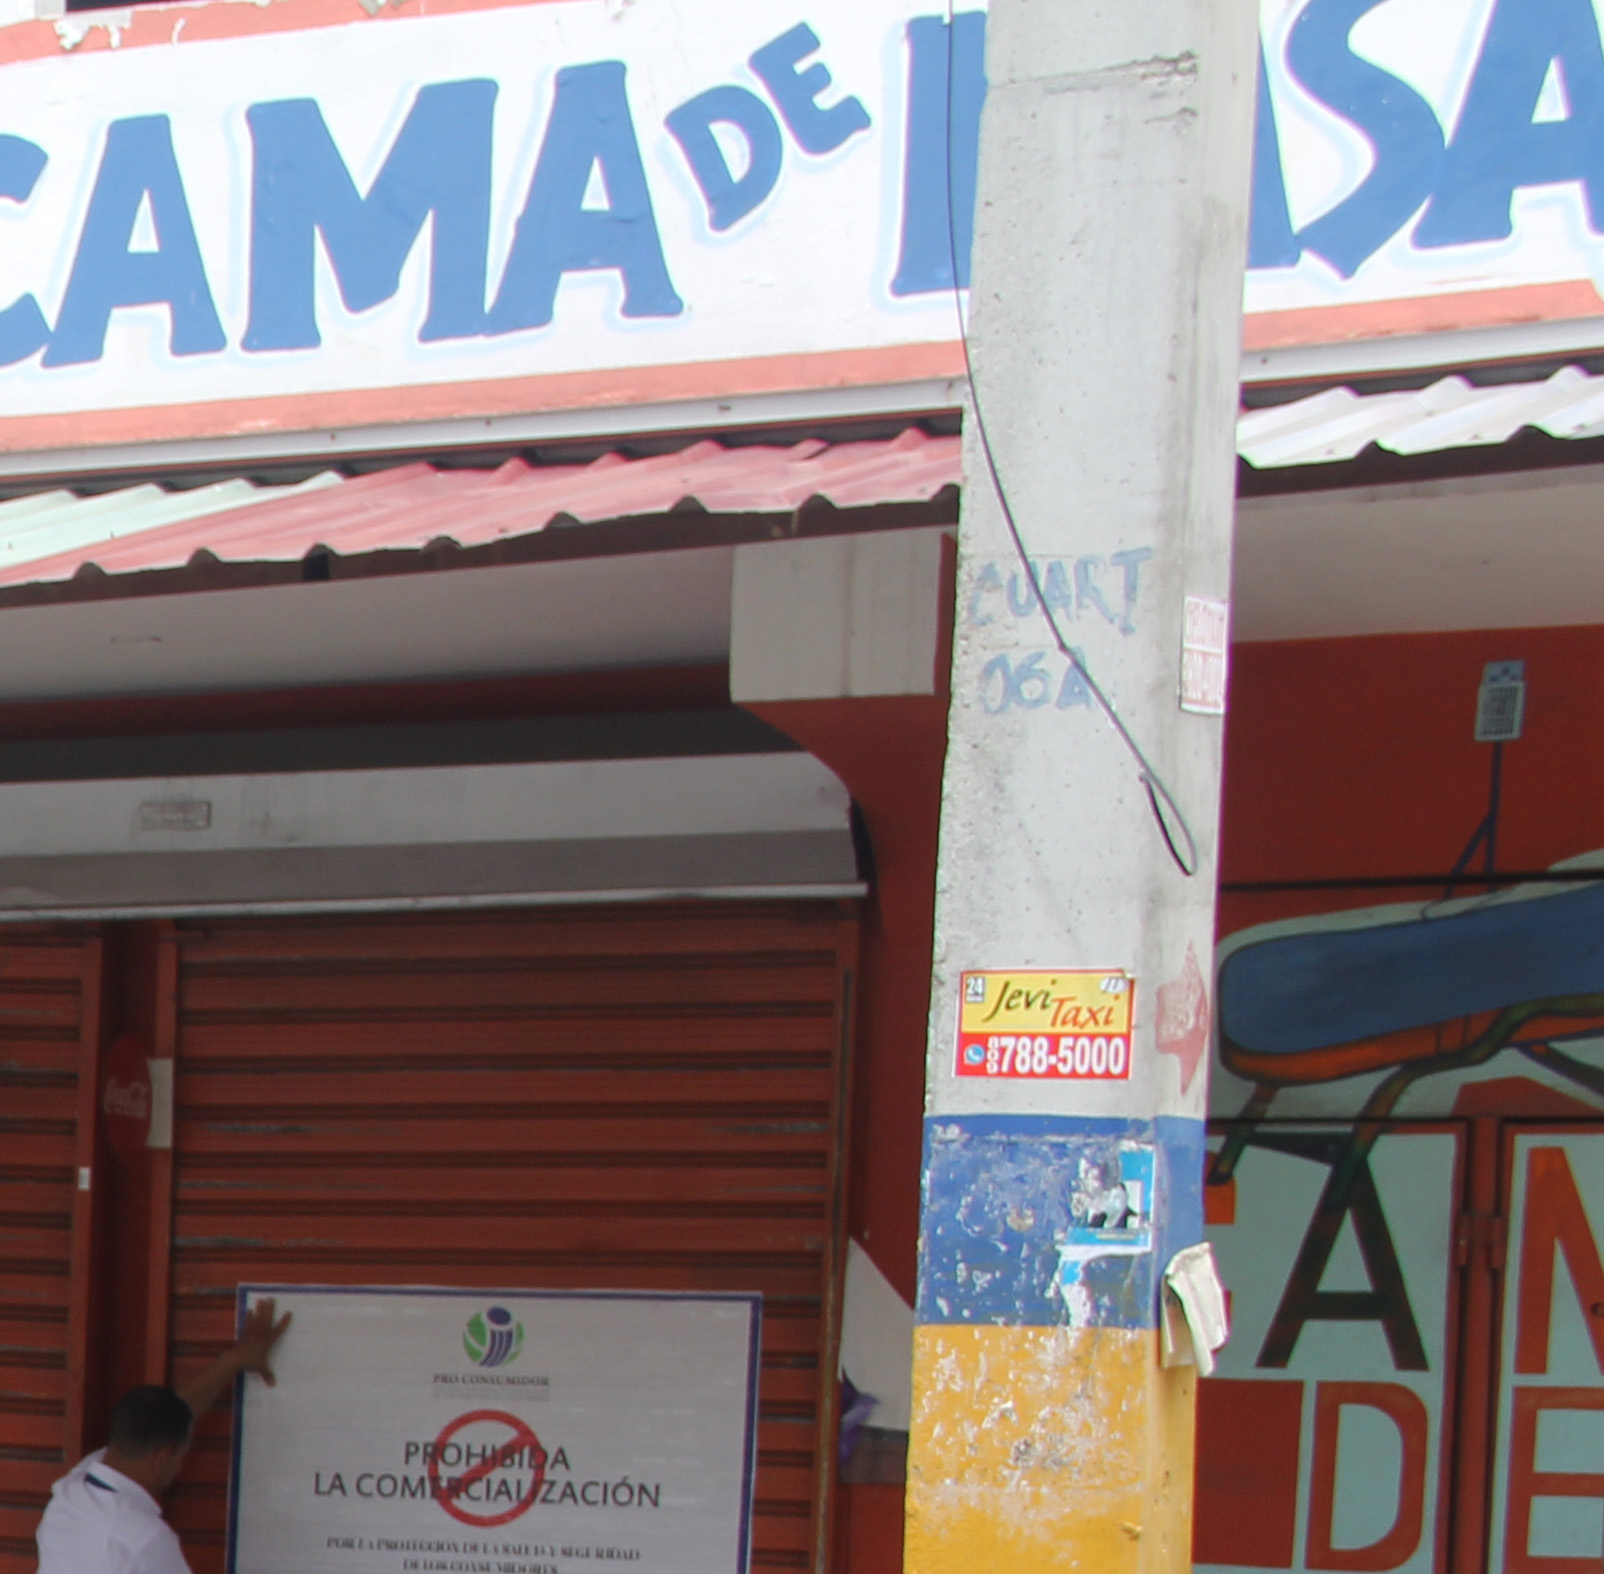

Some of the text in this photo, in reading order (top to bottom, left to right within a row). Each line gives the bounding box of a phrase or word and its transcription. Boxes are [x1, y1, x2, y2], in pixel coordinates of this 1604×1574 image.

[1049, 995, 1121, 1030] Taxi
[1000, 1036, 1126, 1076] 788-5000
[404, 1441, 570, 1472] PROHIBIDA
[314, 1472, 346, 1497] LA
